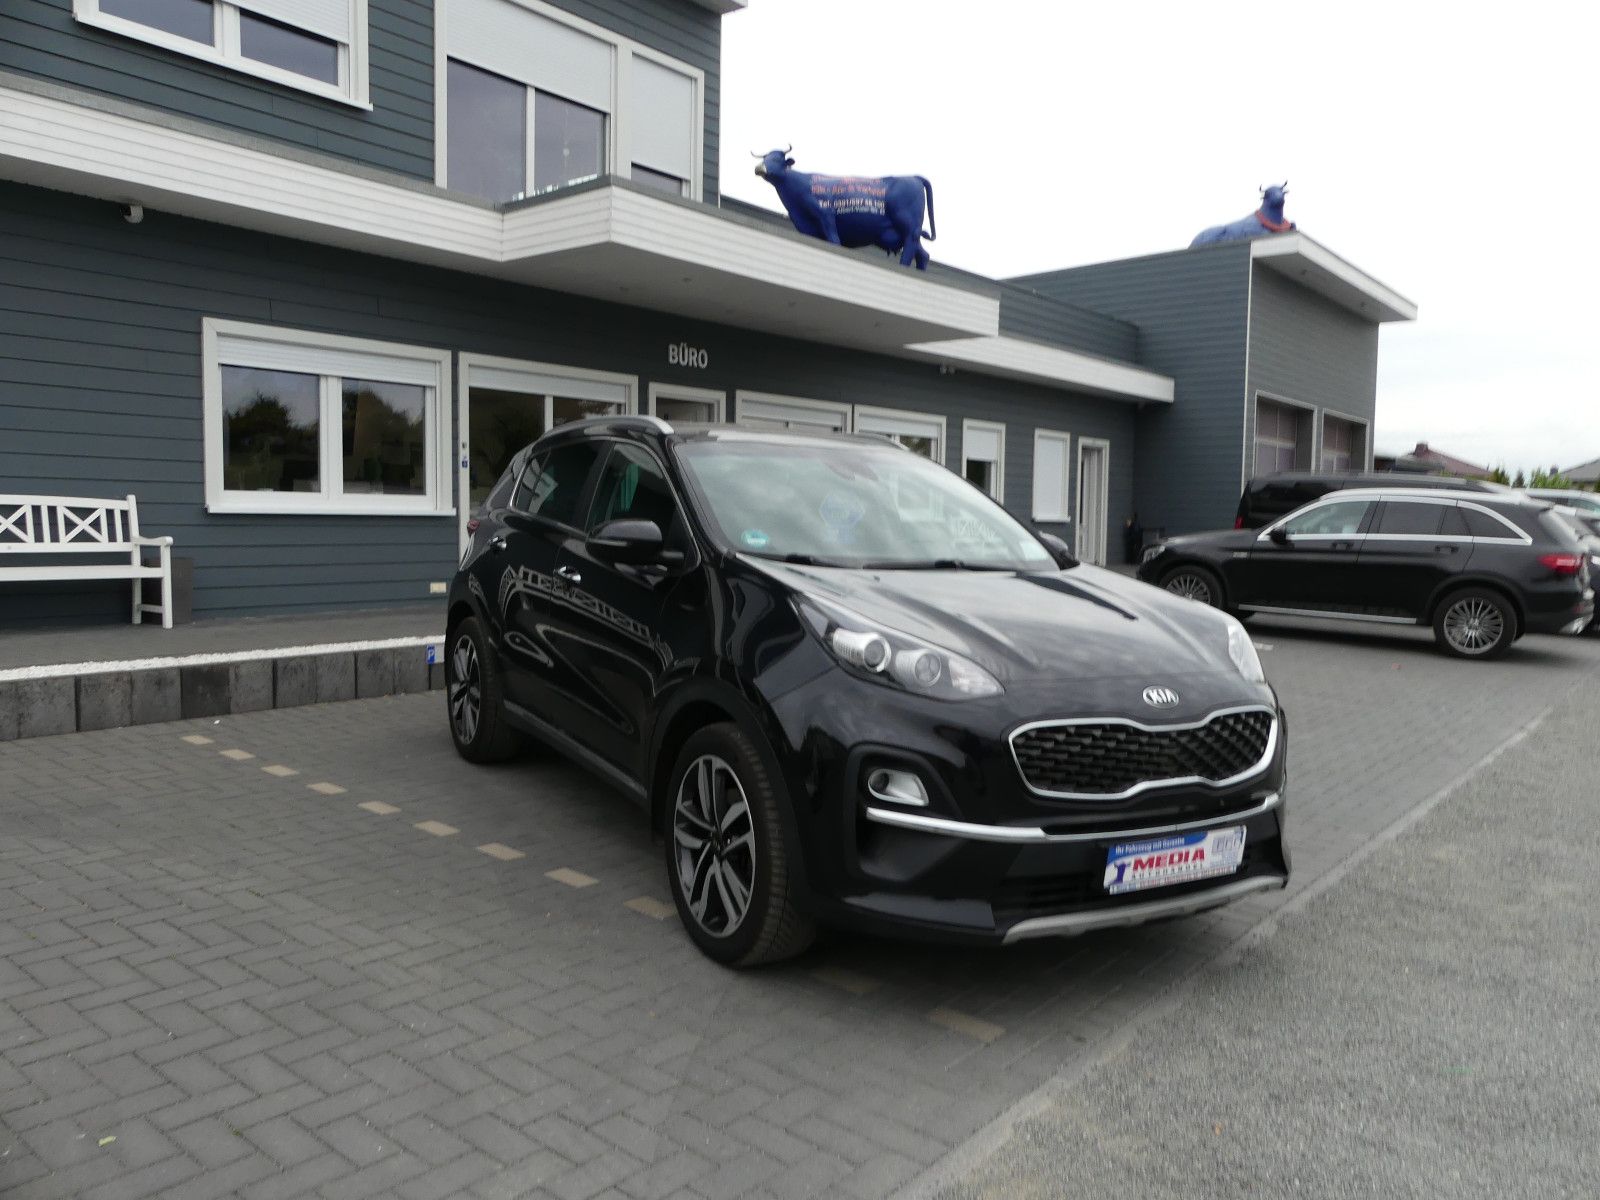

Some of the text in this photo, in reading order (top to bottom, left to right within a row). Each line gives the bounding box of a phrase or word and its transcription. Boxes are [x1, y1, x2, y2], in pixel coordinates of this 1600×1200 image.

[668, 342, 708, 369] BÜRO
[1148, 688, 1176, 704] KIA
[1132, 847, 1205, 872] MEDIA
